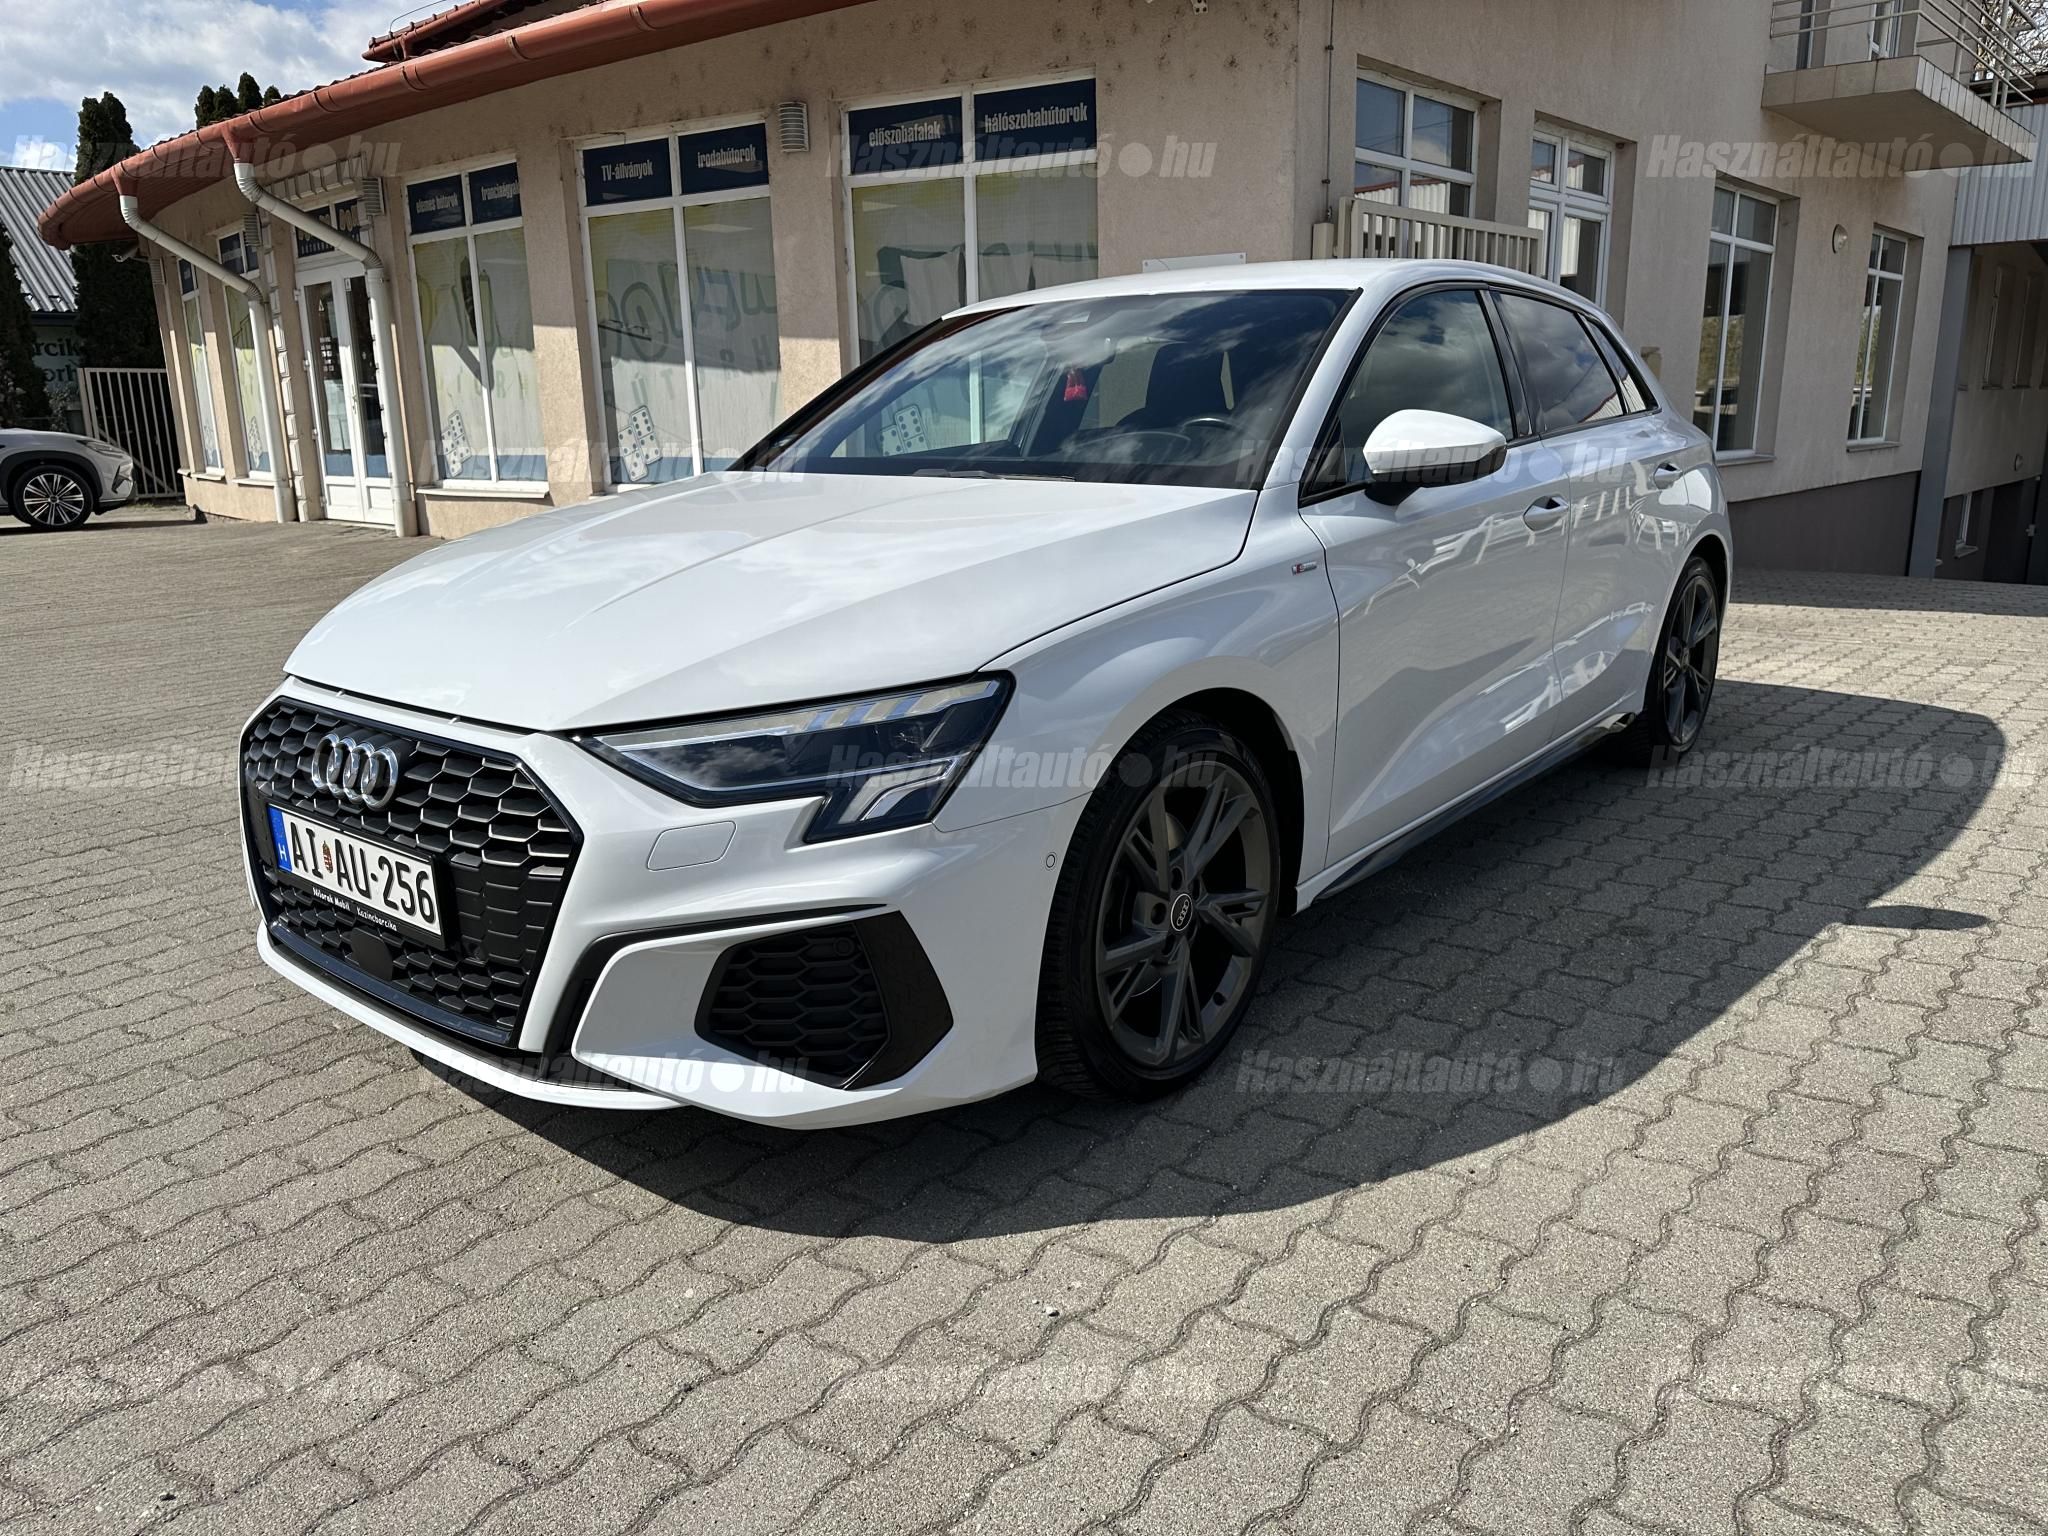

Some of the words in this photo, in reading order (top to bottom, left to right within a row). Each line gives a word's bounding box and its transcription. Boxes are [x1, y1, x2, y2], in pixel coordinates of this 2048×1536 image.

[985, 103, 1088, 133] hálószobabútorok
[869, 121, 941, 147] előszobafalak
[697, 144, 757, 168] irodabútorok
[601, 160, 653, 181] TV-állványok
[278, 843, 288, 862] H
[290, 821, 323, 880] AI
[334, 838, 436, 925] AU-256
